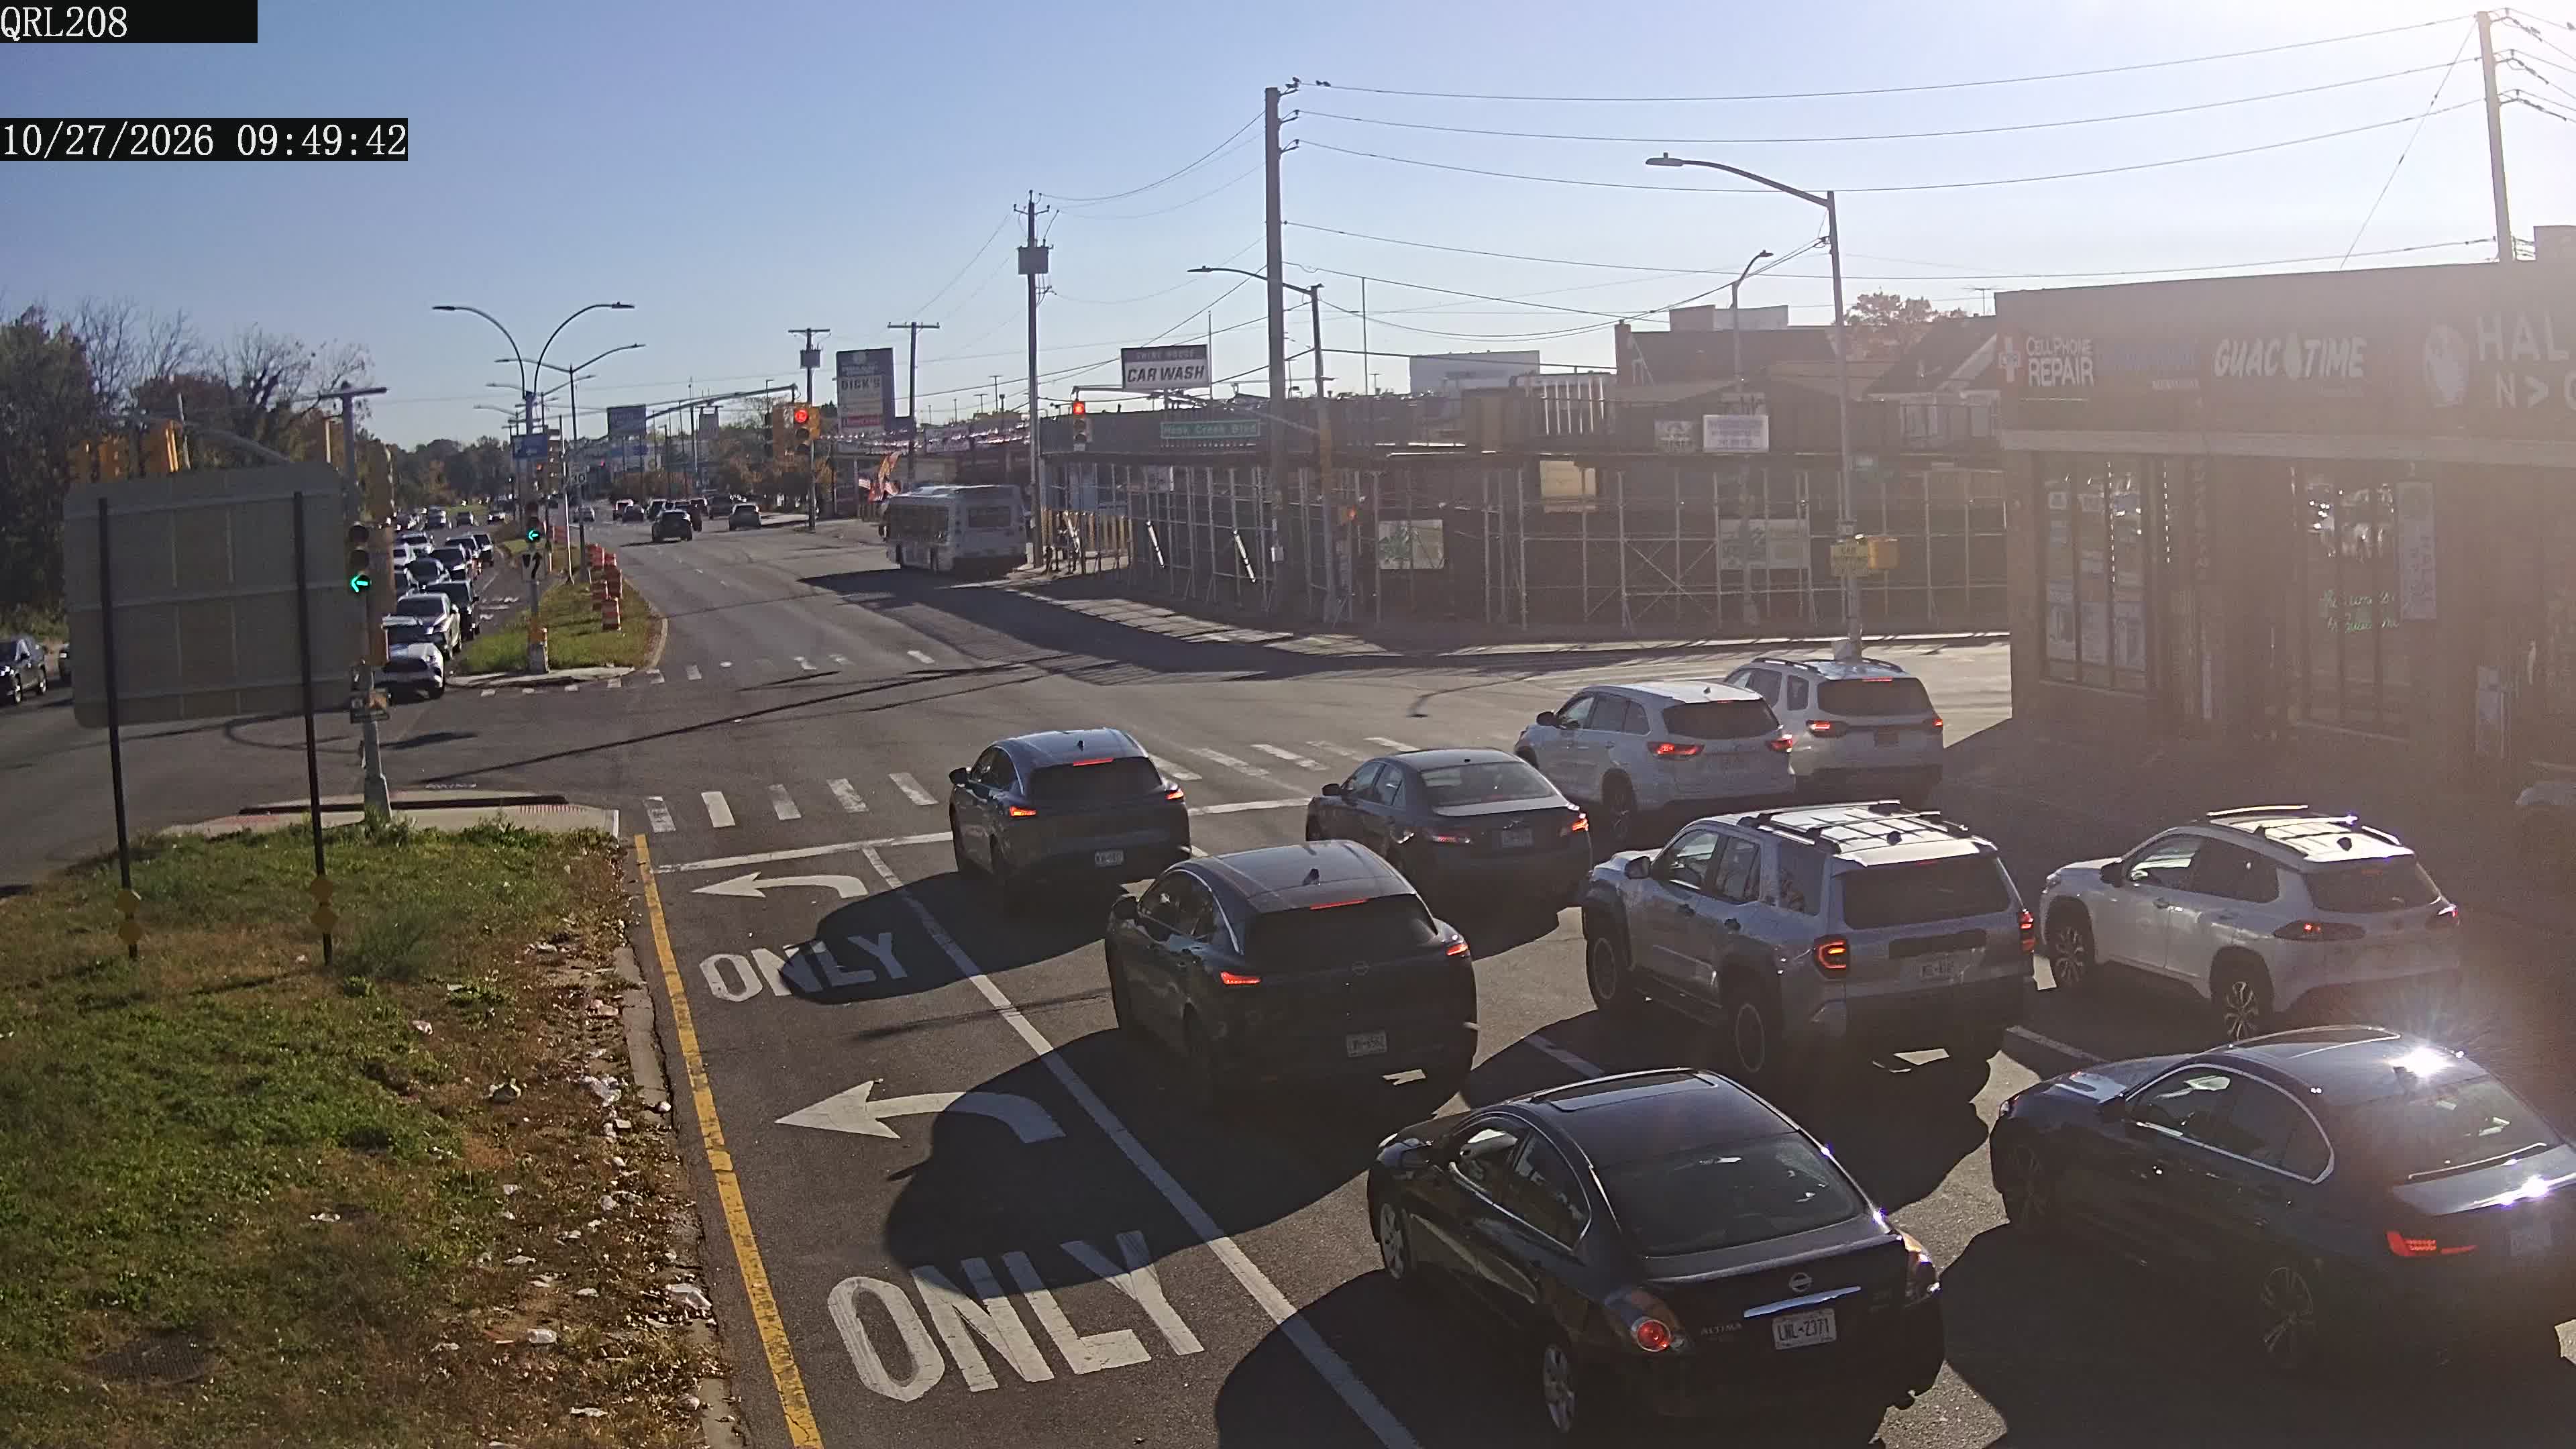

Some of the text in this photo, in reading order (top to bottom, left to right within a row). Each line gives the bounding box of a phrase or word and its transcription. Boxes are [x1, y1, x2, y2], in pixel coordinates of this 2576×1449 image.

[1128, 365, 1205, 382] CAR WASH
[2028, 357, 2094, 387] REPAIR
[2213, 338, 2282, 380] GUAC
[2304, 335, 2367, 380] TIME
[841, 377, 881, 391] DICK'S
[700, 932, 907, 1002] ONLY
[827, 1230, 1205, 1403] ONLY
